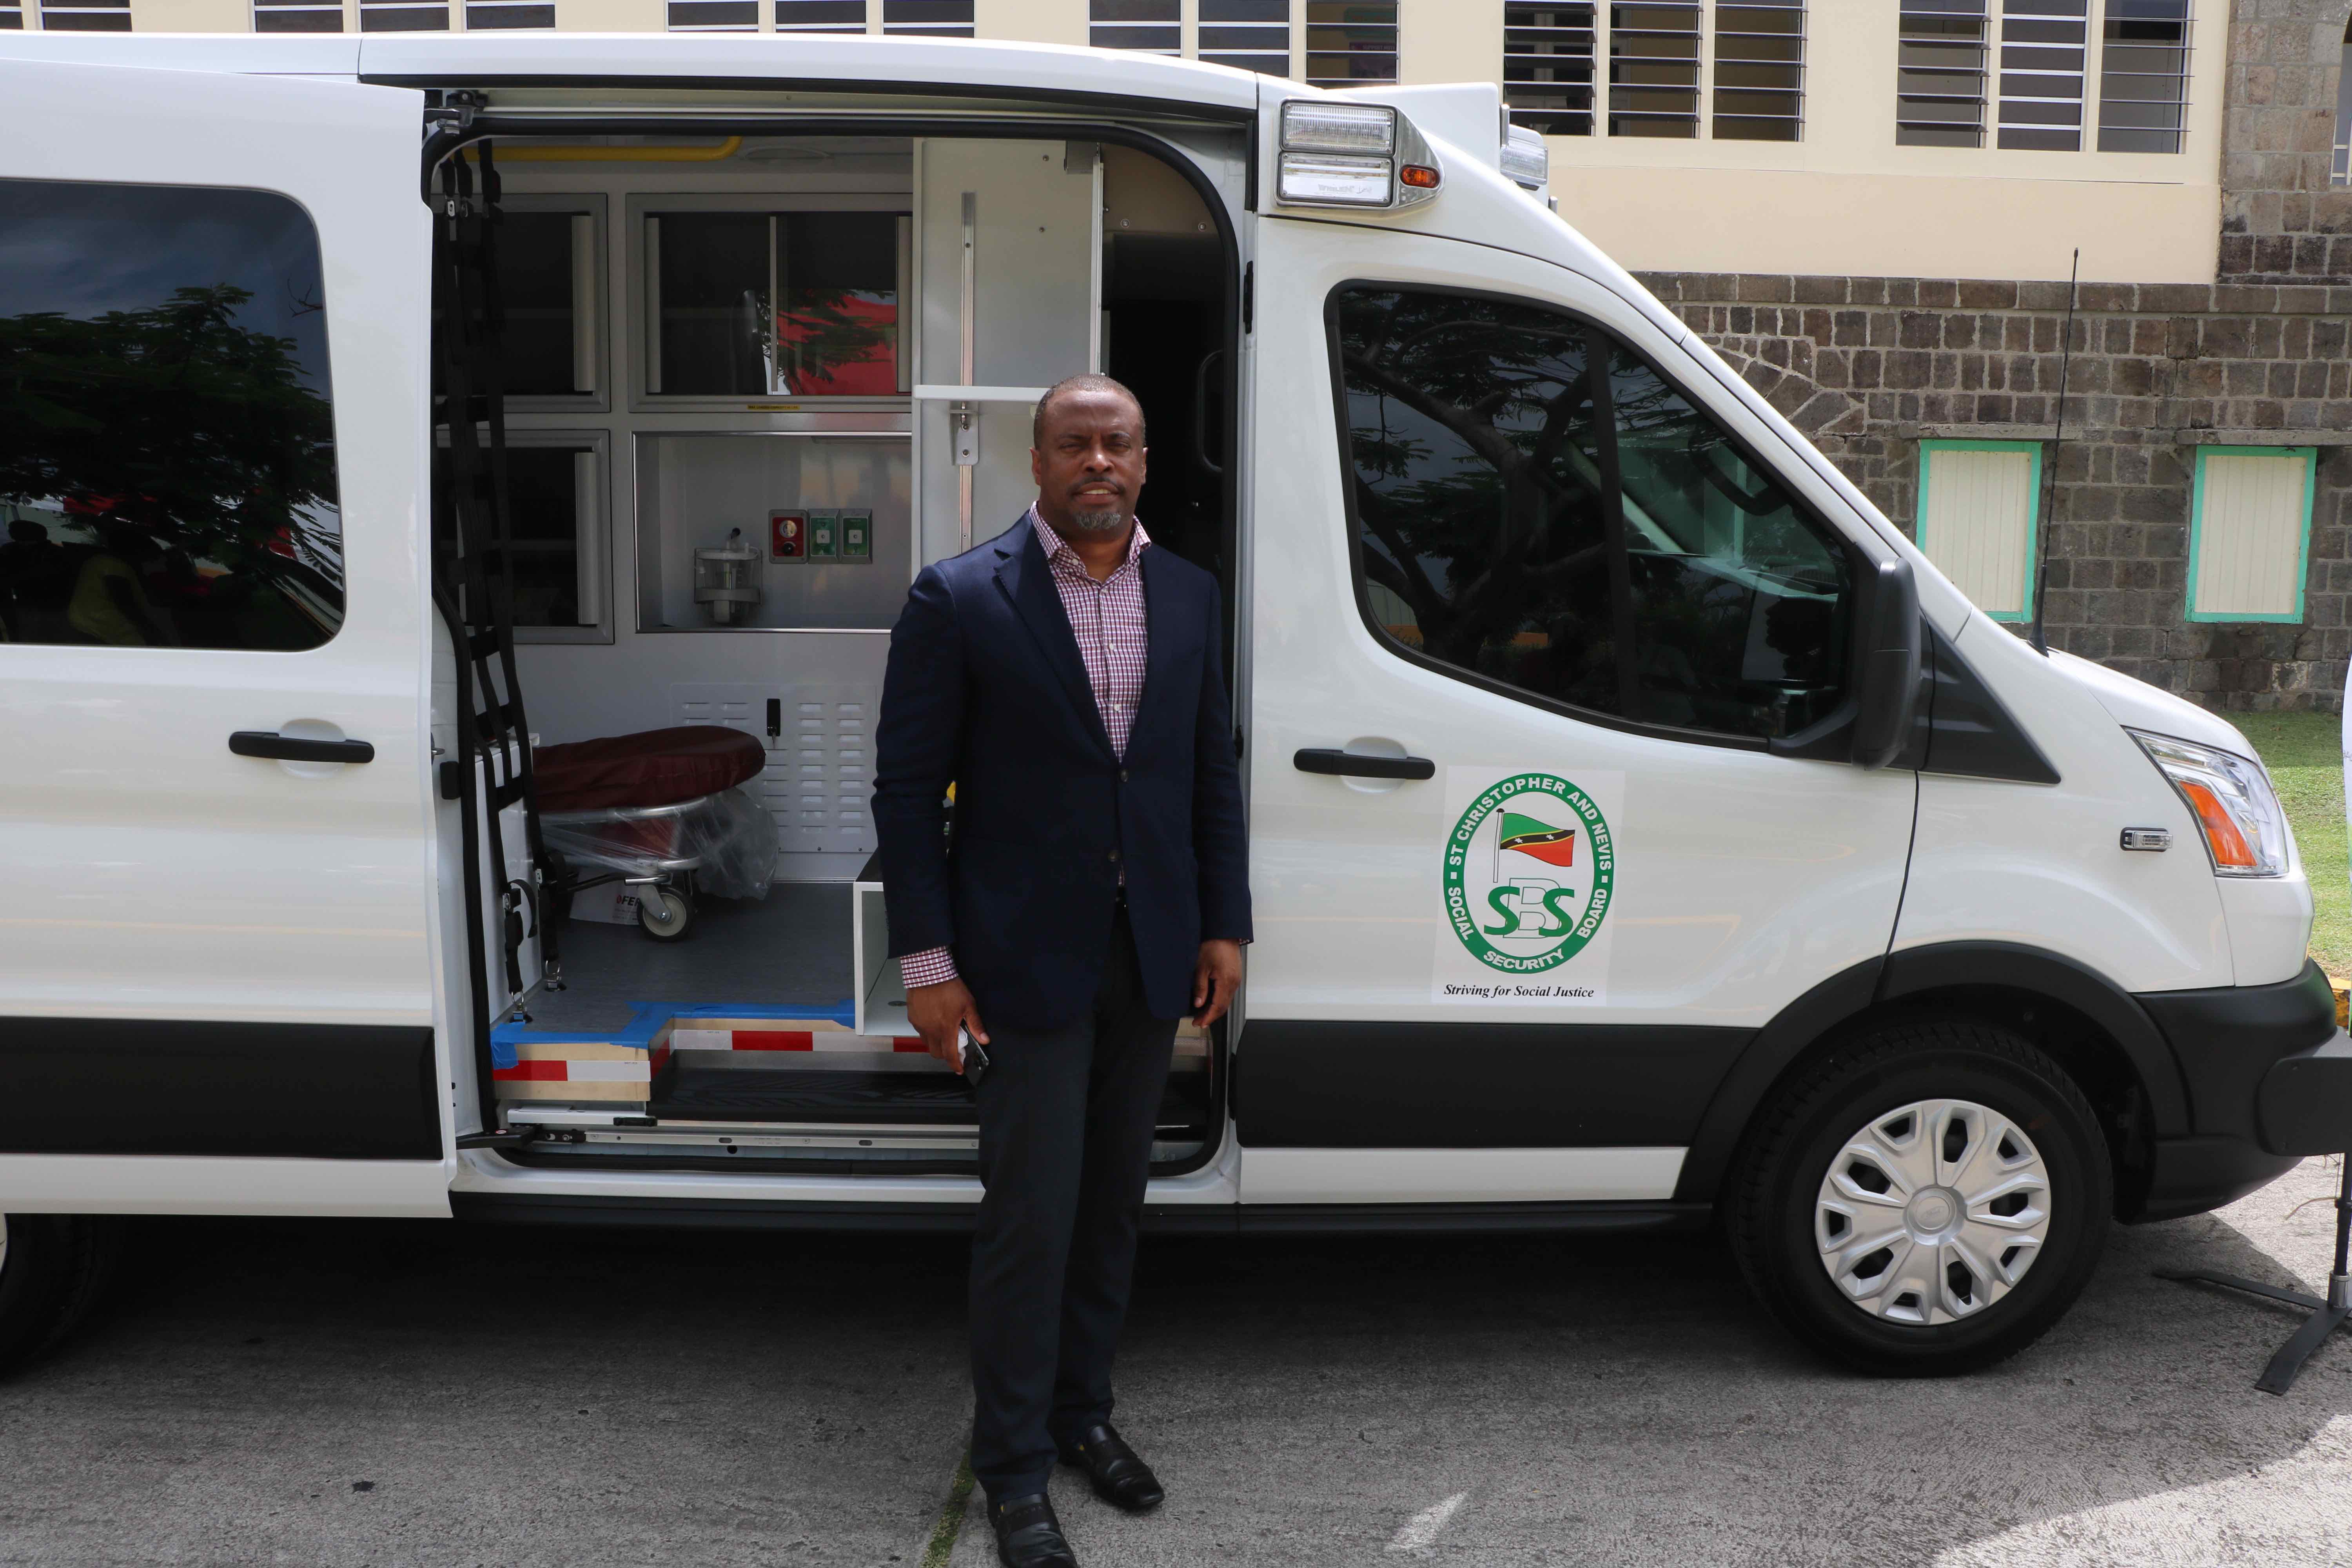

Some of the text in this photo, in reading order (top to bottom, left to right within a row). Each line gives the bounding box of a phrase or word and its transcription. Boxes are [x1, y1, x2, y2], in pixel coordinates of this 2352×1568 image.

[1449, 777, 1612, 871] ST CHRISTOPHER AND NEVIS
[1448, 887, 1607, 970] SOCIAL SECURITY BOARD
[1444, 984, 1594, 998] Striving for Social Justice
